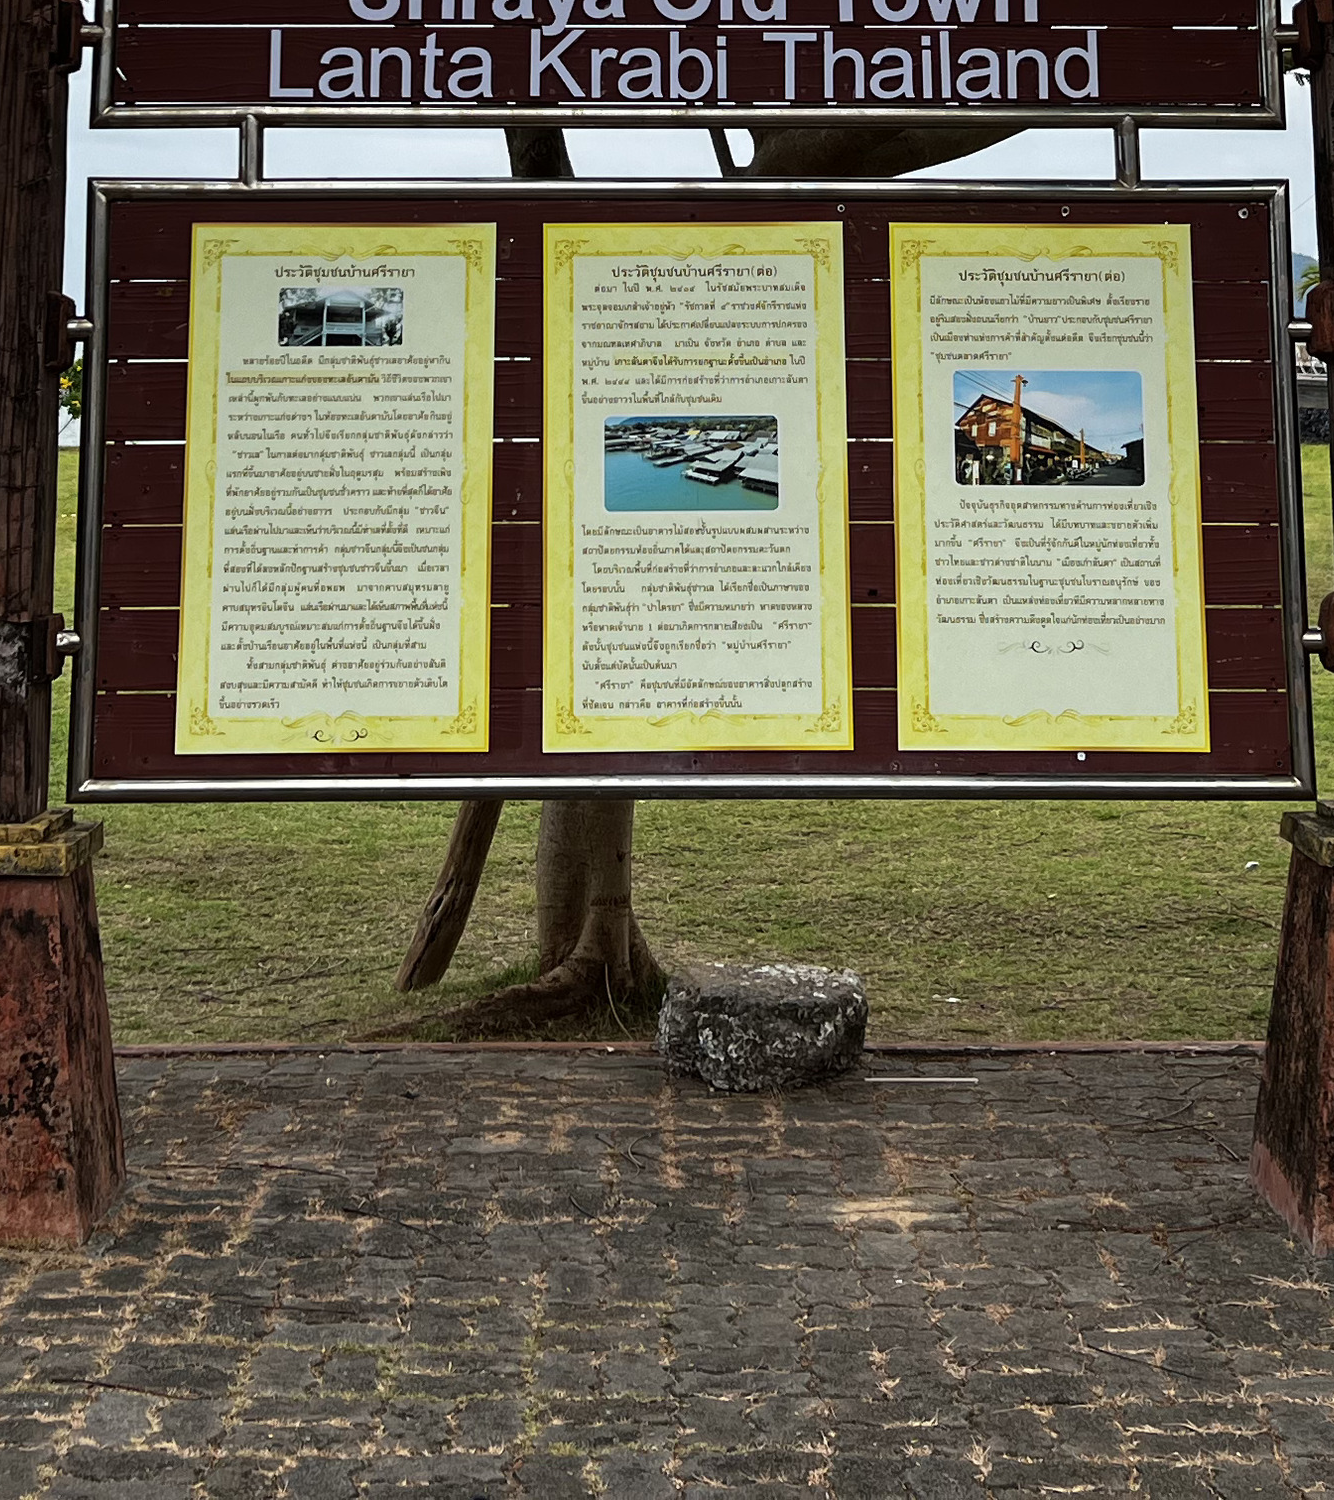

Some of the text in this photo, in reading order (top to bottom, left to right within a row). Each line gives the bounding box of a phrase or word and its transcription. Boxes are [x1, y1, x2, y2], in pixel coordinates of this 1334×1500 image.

[269, 28, 1100, 100] Lanta Krabi Thailand
